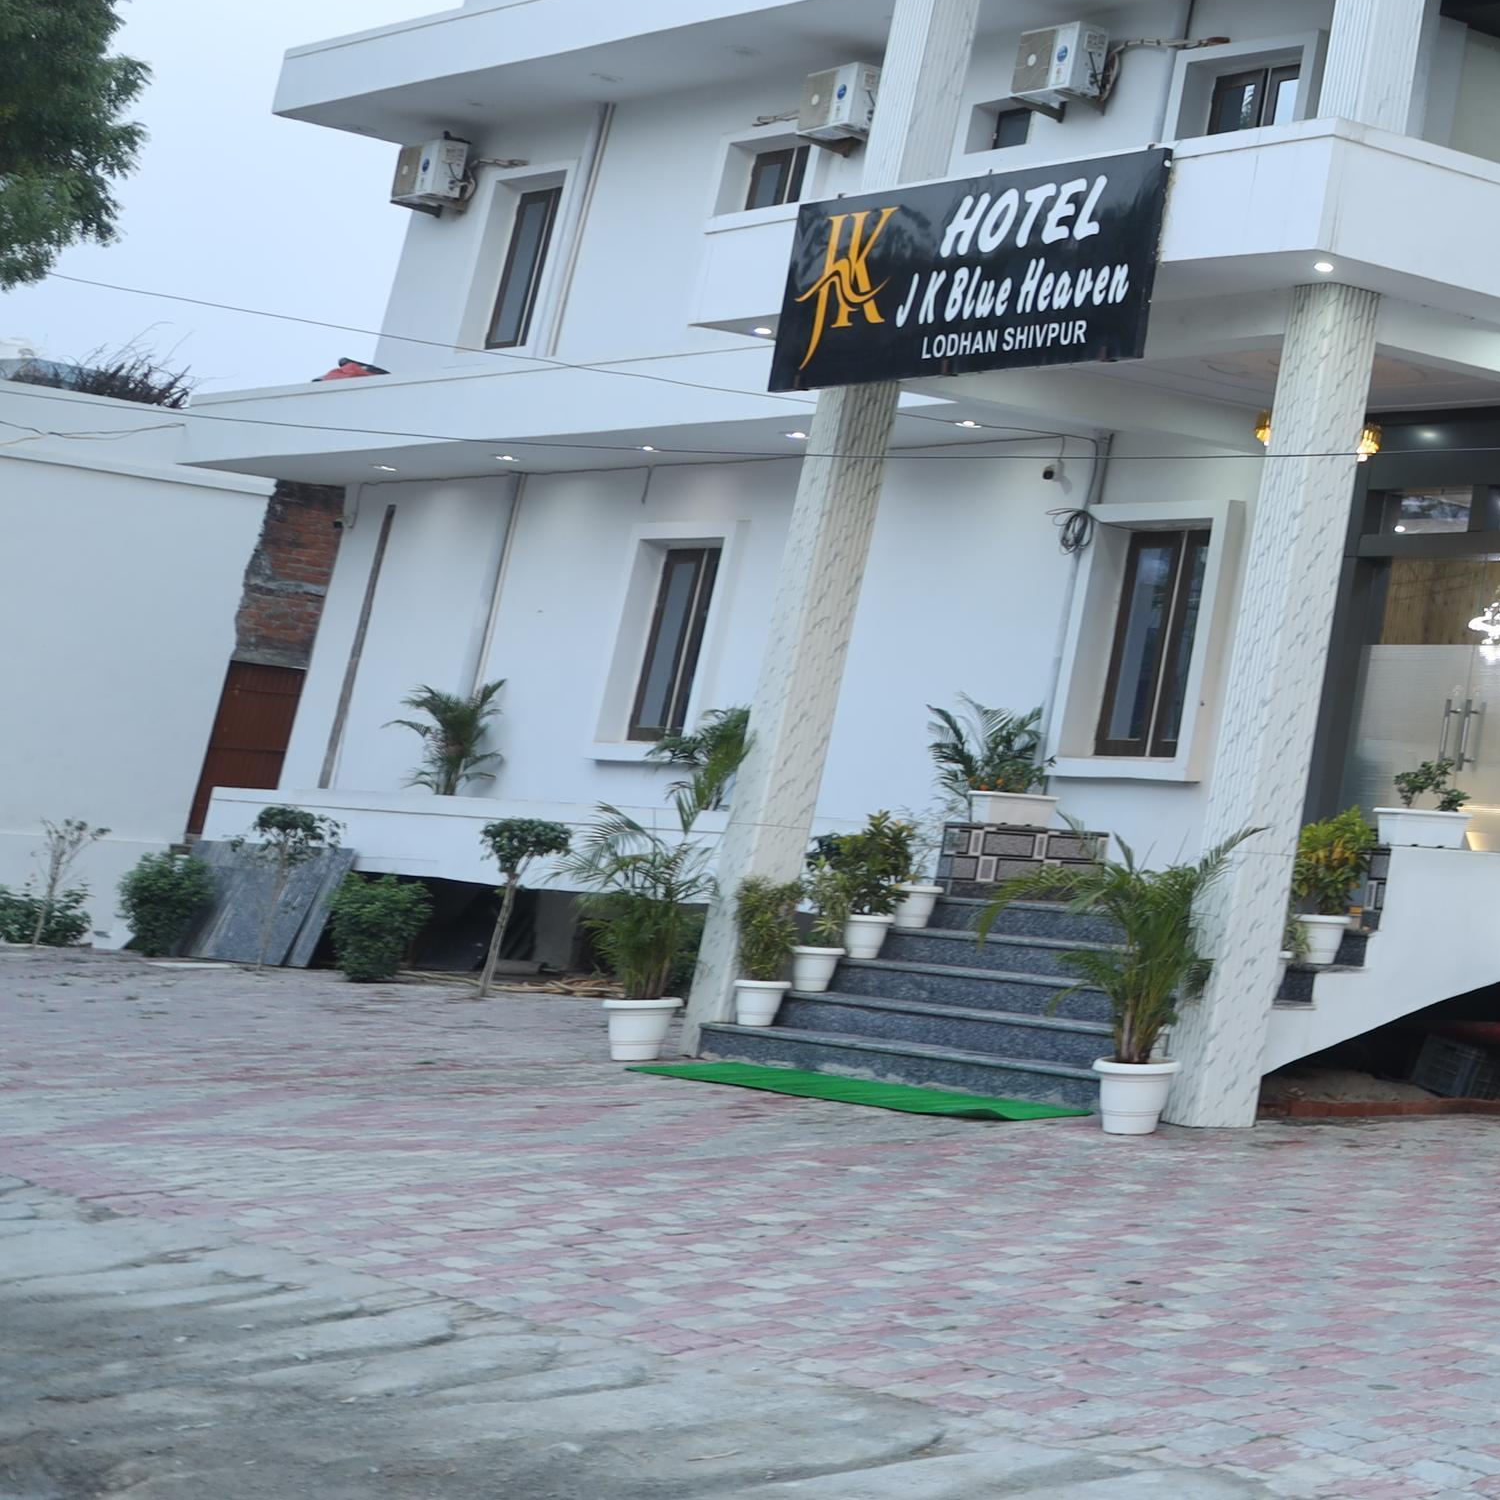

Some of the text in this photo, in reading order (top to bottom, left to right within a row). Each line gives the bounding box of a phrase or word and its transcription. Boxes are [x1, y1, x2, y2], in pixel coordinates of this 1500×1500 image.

[940, 175, 1108, 258] HOTEL
[896, 257, 1130, 328] J K Blue Heaven
[921, 319, 1087, 359] LODHAN SHIVPUR
